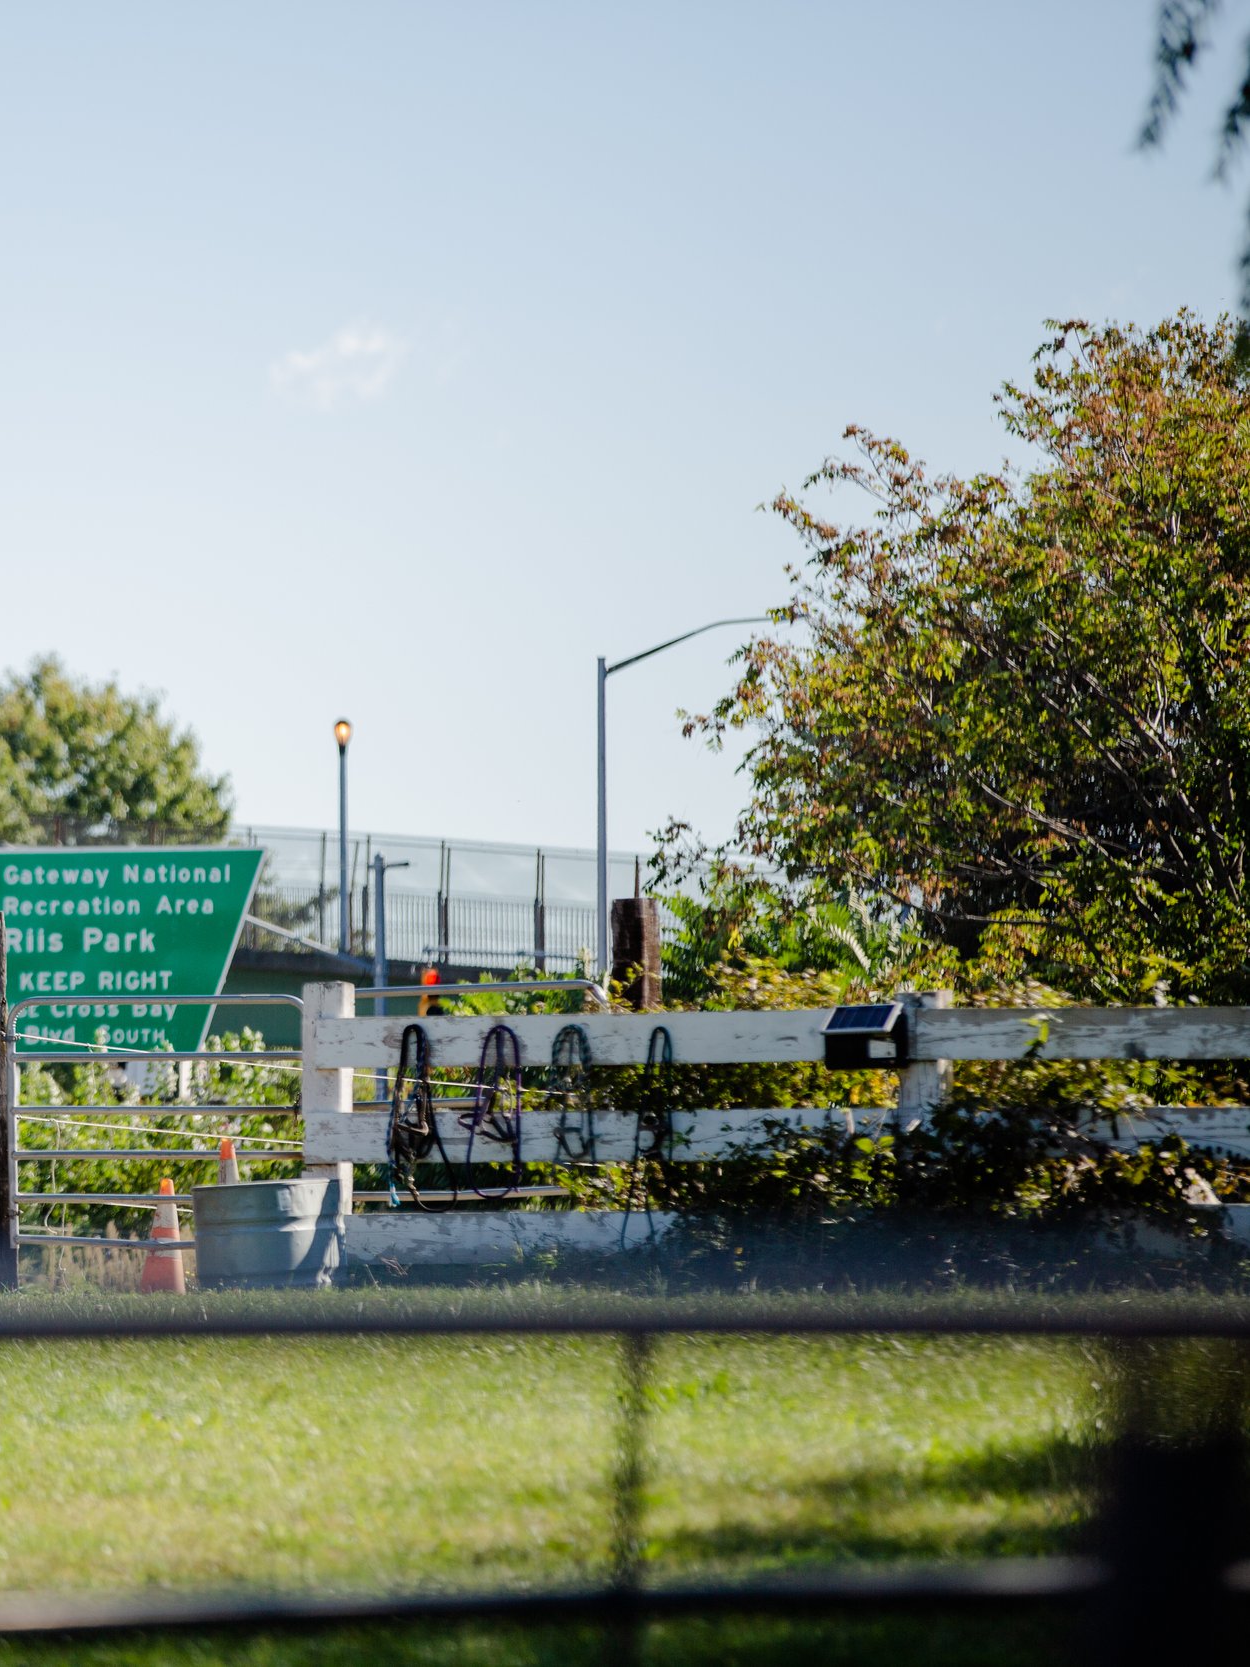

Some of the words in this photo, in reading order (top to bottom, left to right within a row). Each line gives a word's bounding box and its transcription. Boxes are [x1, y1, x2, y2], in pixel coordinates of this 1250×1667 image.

[4, 865, 109, 889] Gateway
[122, 864, 231, 884] National
[3, 896, 141, 916] Recreation
[156, 895, 215, 915] Area
[7, 927, 64, 953] Riis
[83, 927, 156, 953] Park
[19, 971, 86, 991] KEEP
[98, 970, 173, 991] RIGHT
[51, 1004, 120, 1018] Cross
[131, 1004, 178, 1022] Bay
[24, 1025, 76, 1046] Blvd
